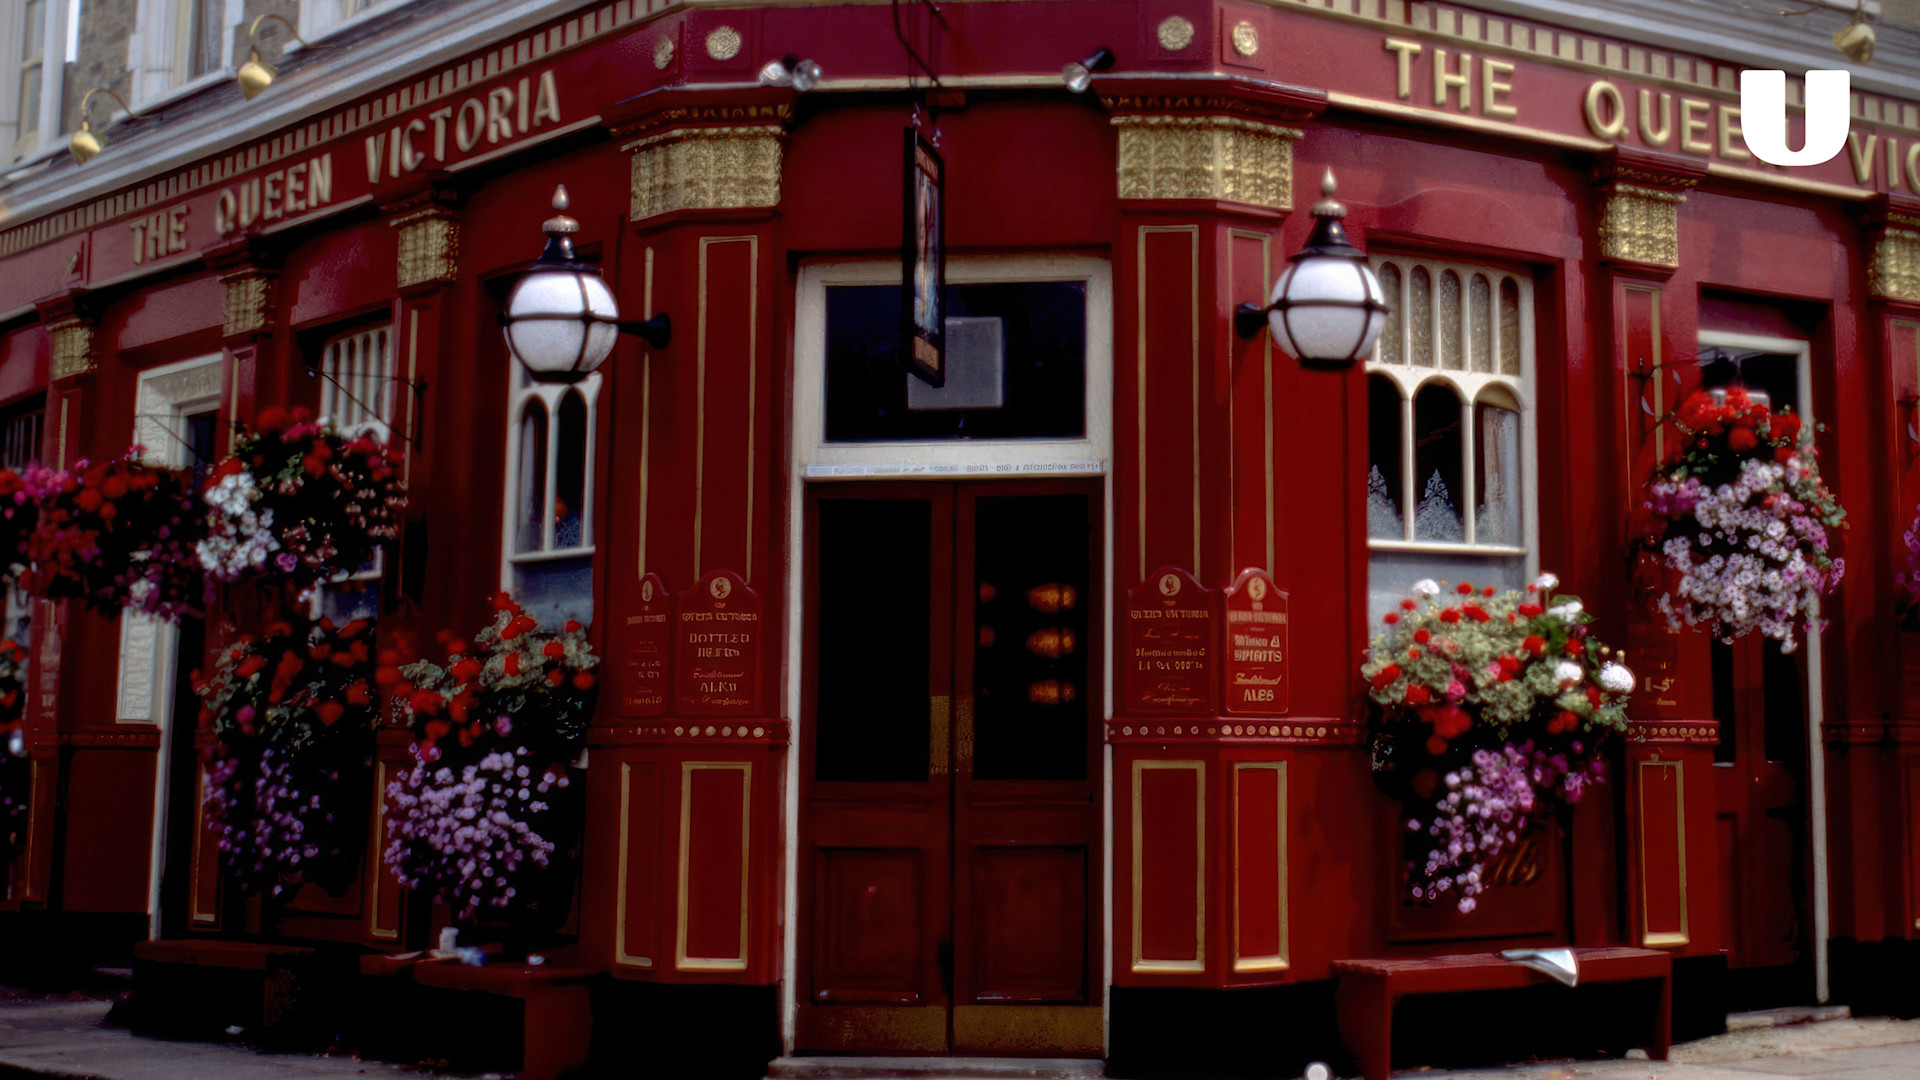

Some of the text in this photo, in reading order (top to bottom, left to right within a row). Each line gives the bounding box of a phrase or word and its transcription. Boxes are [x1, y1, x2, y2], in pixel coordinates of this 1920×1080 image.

[129, 69, 561, 265] THE QUEEN VICTORIA
[1386, 38, 1517, 118] THE
[1583, 80, 1790, 169] QUEE
